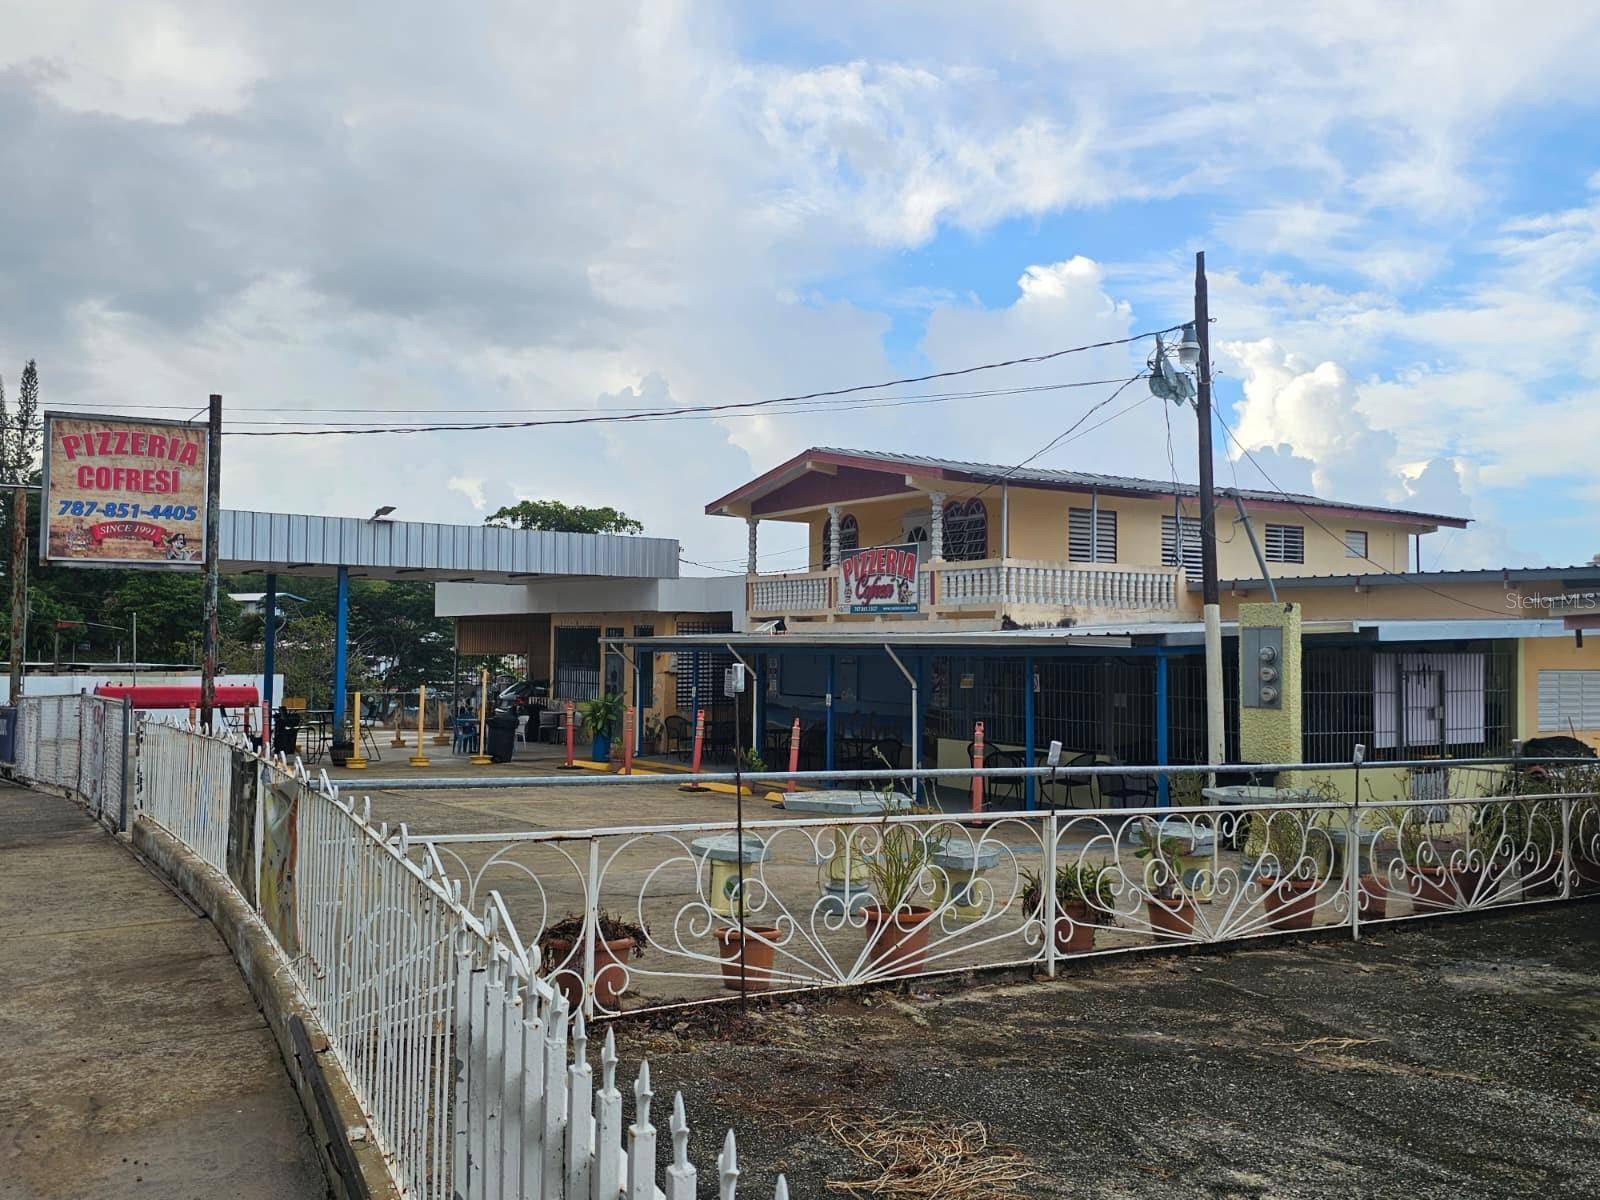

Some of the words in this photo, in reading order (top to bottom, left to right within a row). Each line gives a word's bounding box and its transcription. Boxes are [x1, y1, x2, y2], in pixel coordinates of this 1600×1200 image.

[58, 500, 198, 521] 787-851-4405
[100, 524, 132, 535] SINCE
[134, 525, 156, 536] 1991
[843, 548, 916, 583] PIZZERIA
